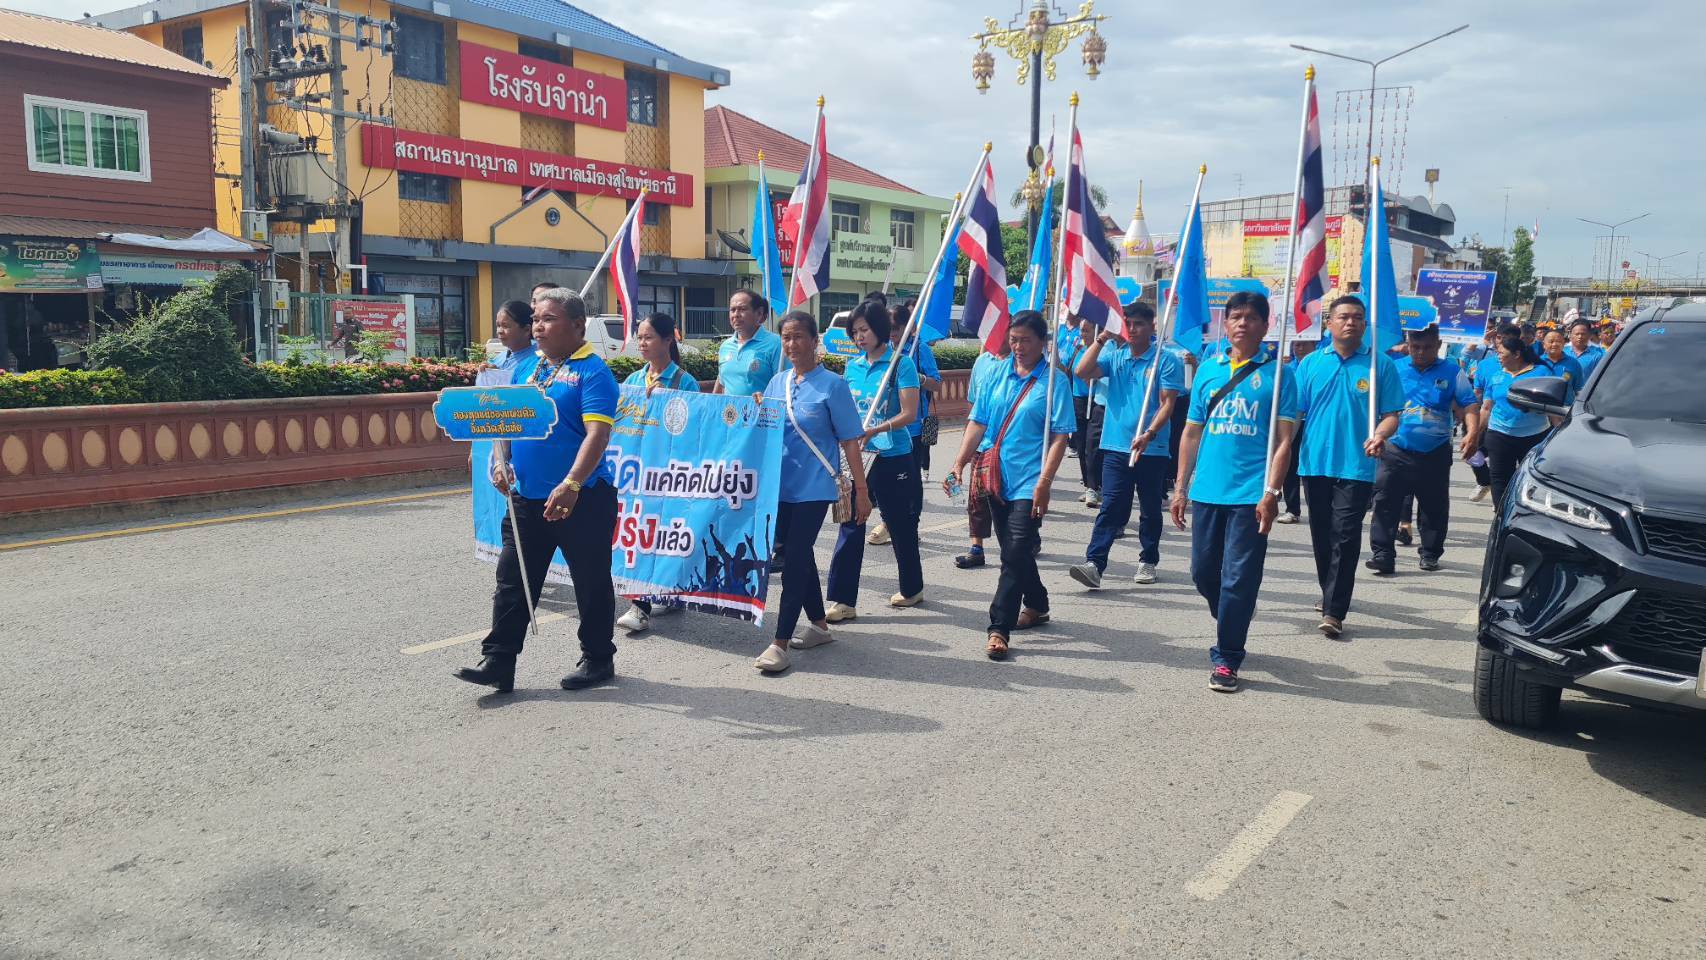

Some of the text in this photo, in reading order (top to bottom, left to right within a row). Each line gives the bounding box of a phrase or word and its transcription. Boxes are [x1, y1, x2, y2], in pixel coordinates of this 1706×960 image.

[483, 55, 608, 119] โรงรับจำนำ
[395, 140, 677, 195] สถานธนานุบาล เทศบาลเมืองสุโขทัยธานี
[645, 463, 753, 505] แค่คิดไปยุ่ง
[656, 521, 691, 553] แล้ว
